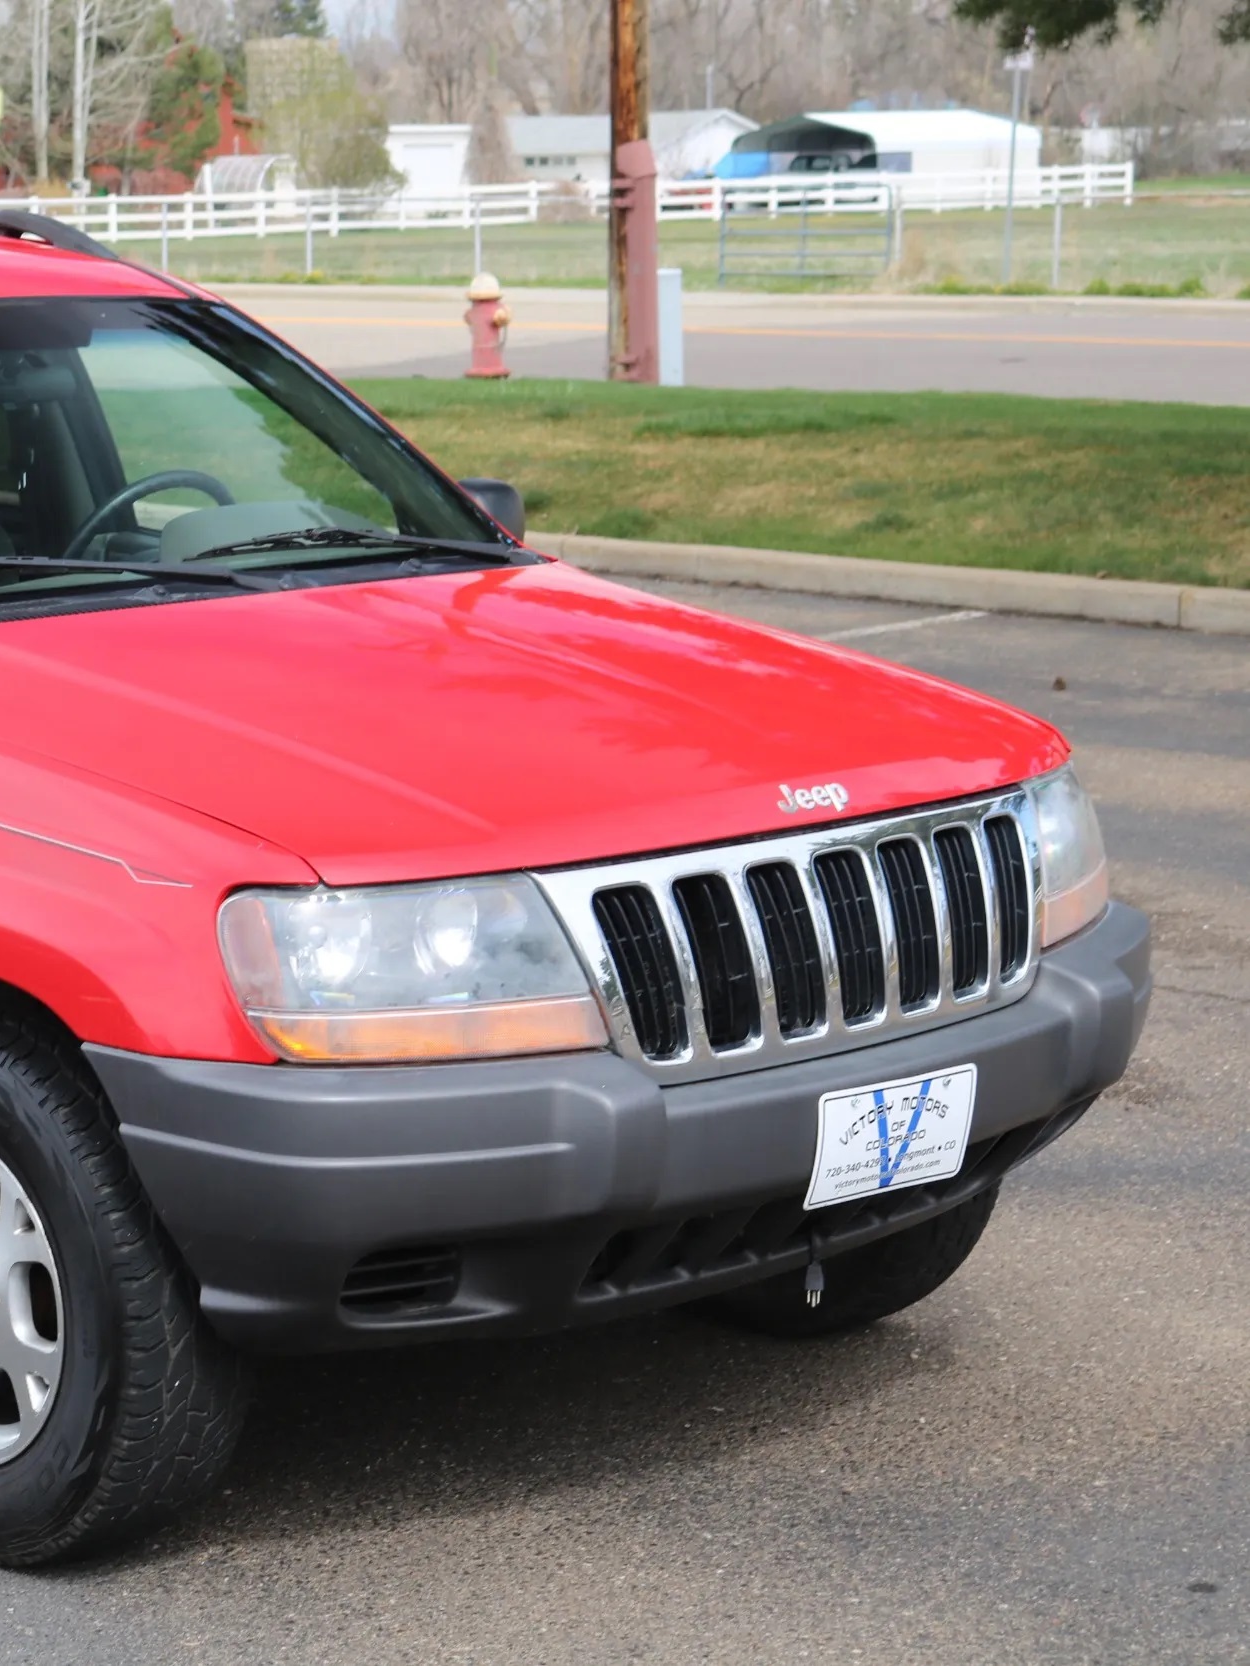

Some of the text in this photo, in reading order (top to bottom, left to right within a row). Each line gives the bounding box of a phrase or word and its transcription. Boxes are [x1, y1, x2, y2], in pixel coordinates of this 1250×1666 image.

[777, 783, 849, 814] Jeep
[839, 1095, 950, 1146] VICTORY MOTORS
[890, 1120, 907, 1132] OF
[865, 1129, 926, 1152] COLORADO
[943, 1140, 956, 1151] CO
[834, 1159, 941, 1190] victorymotocolorado.com
